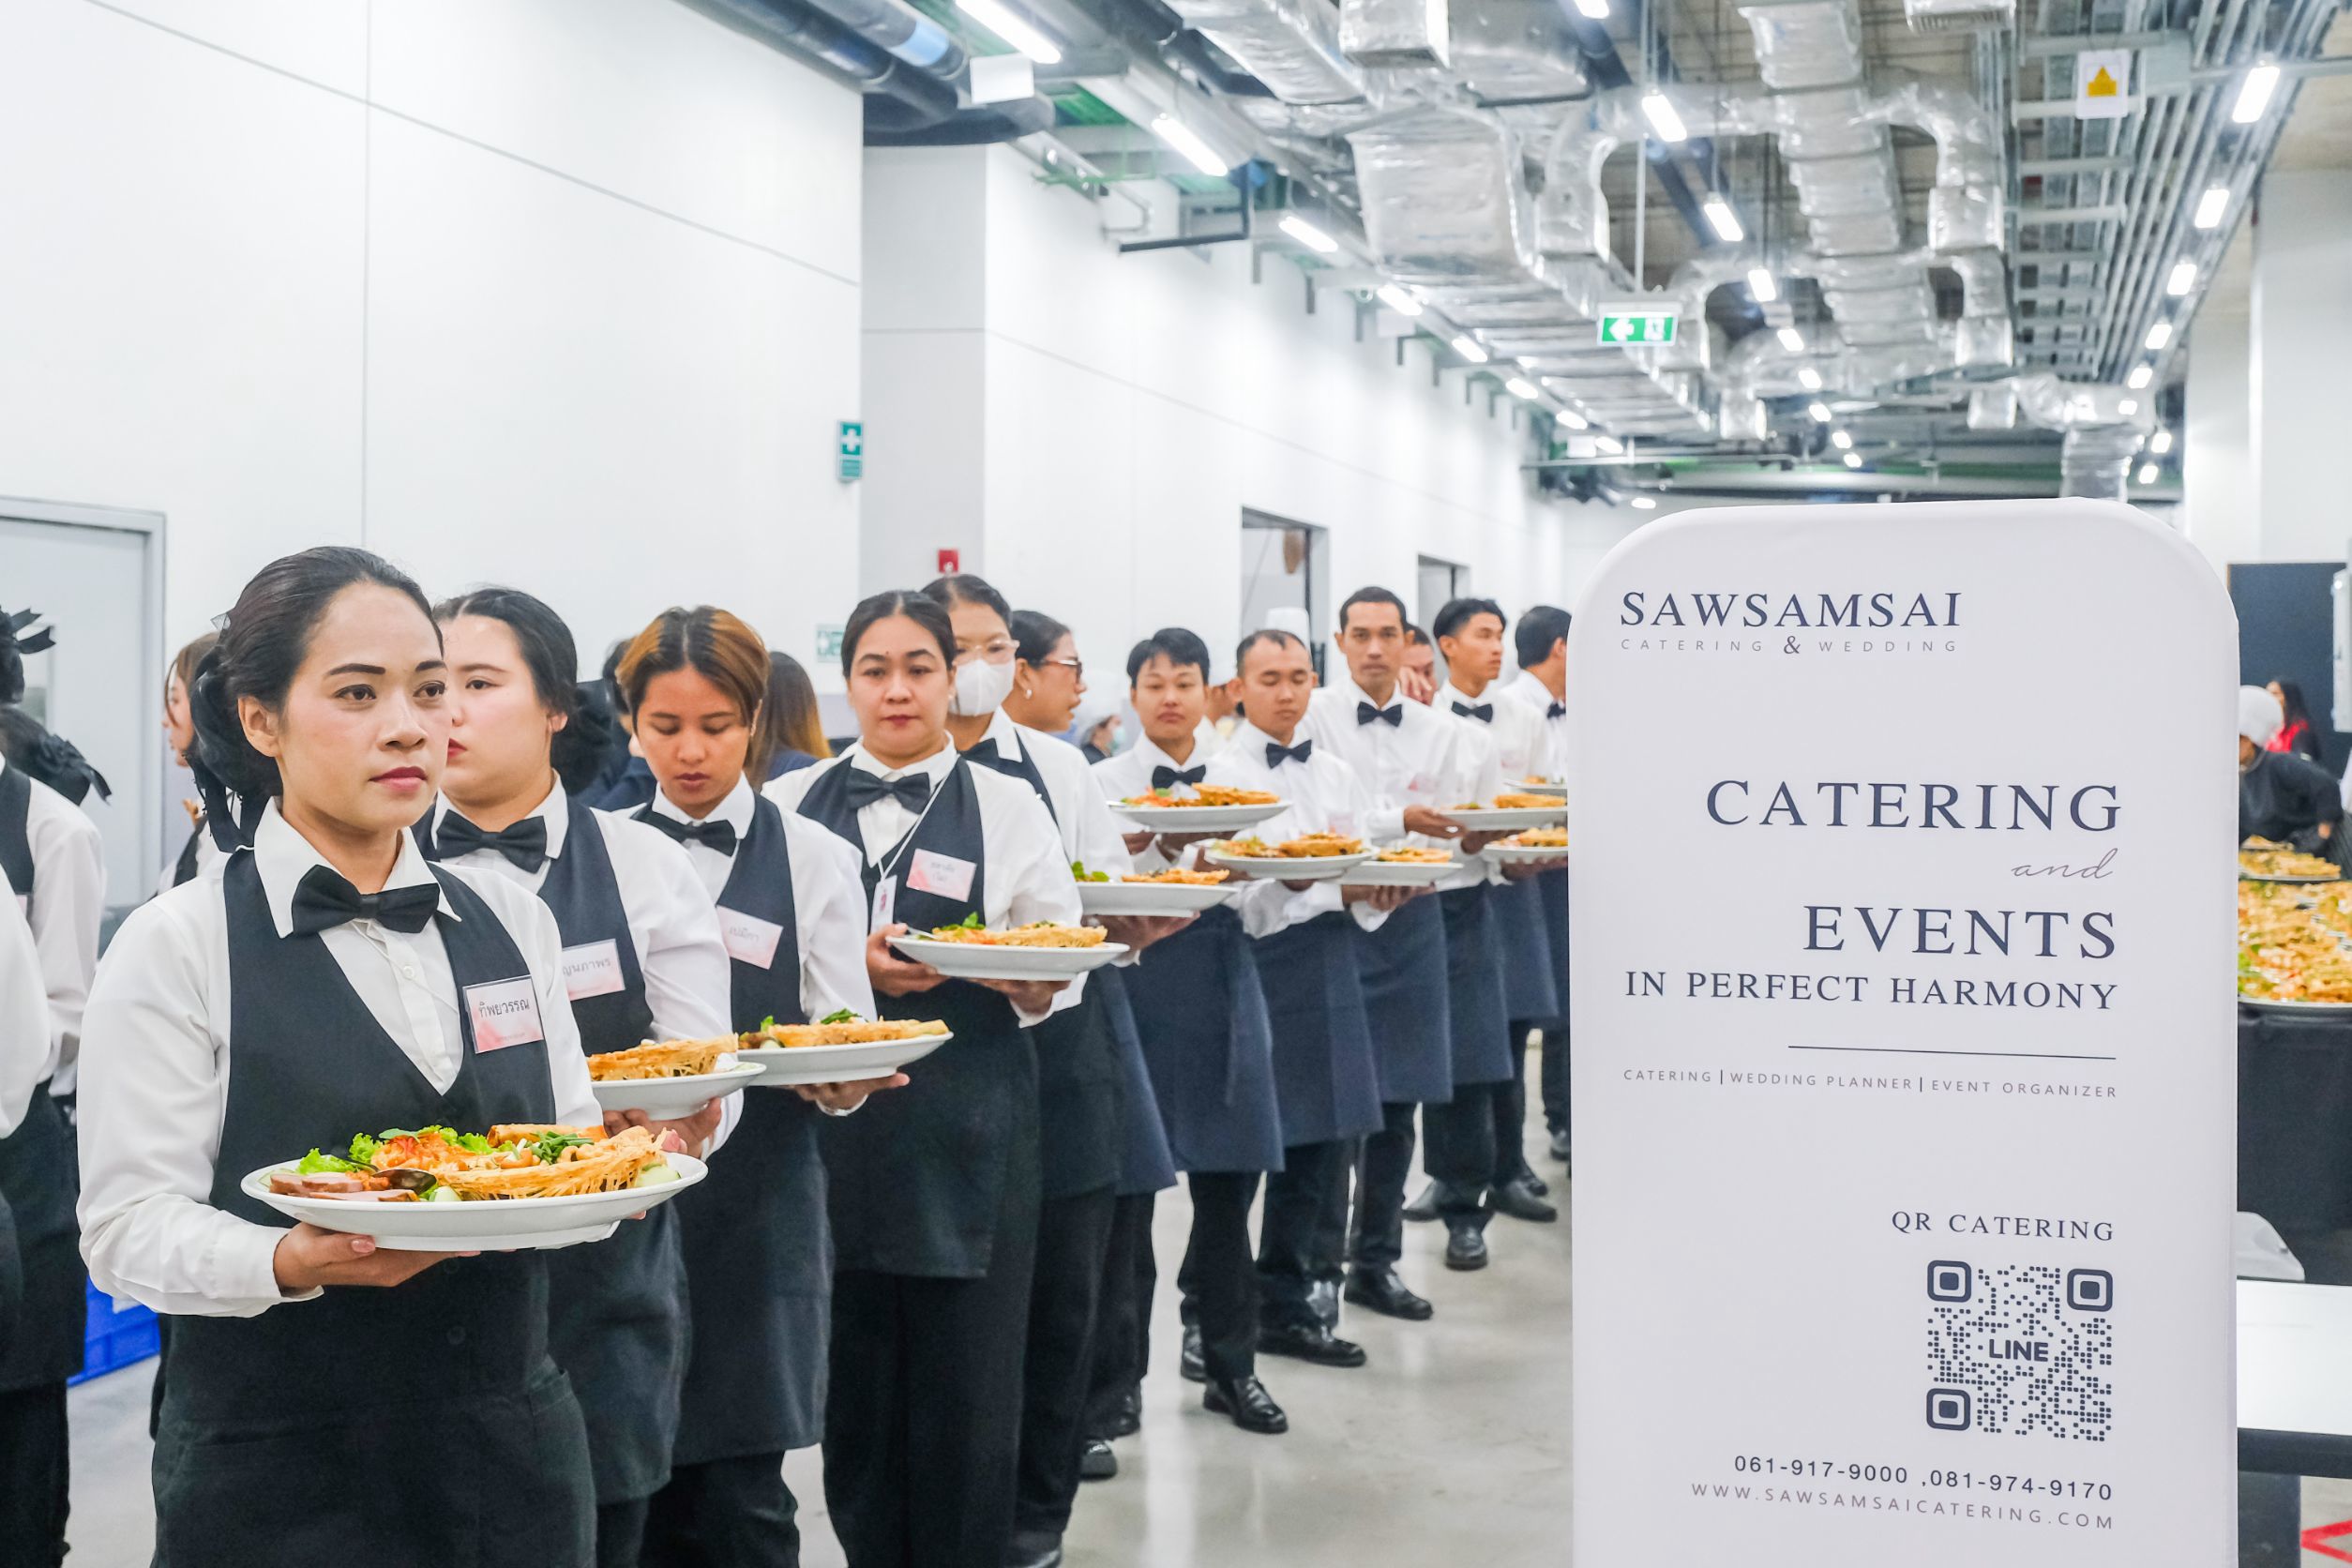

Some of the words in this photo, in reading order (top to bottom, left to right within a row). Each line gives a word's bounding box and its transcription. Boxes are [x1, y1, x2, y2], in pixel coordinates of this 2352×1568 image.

[1620, 591, 1963, 627] SAWSAMSAI
[1621, 639, 1761, 653] CATERING
[1783, 635, 1802, 655] &
[1818, 641, 1955, 653] WEDDING
[1706, 779, 2122, 833] CATERING
[2011, 847, 2118, 880] and
[1802, 905, 2116, 959] EVENTS
[1624, 971, 1666, 997] IN
[1686, 972, 1869, 1003] PERFECT
[1890, 977, 2118, 1010] HARMONY
[478, 997, 531, 1018] ทิพยวรรณ
[1932, 1079, 1990, 1093] EVENT
[2002, 1082, 2116, 1098] ORGANIZER
[1892, 1211, 1932, 1234] QR
[1948, 1214, 2114, 1242] CATERING
[1988, 1338, 2049, 1363] LINE
[1734, 1455, 1907, 1484] 061-917-9000
[1691, 1483, 2112, 1530] WWW.SAWSAMSAICATERING.COM
